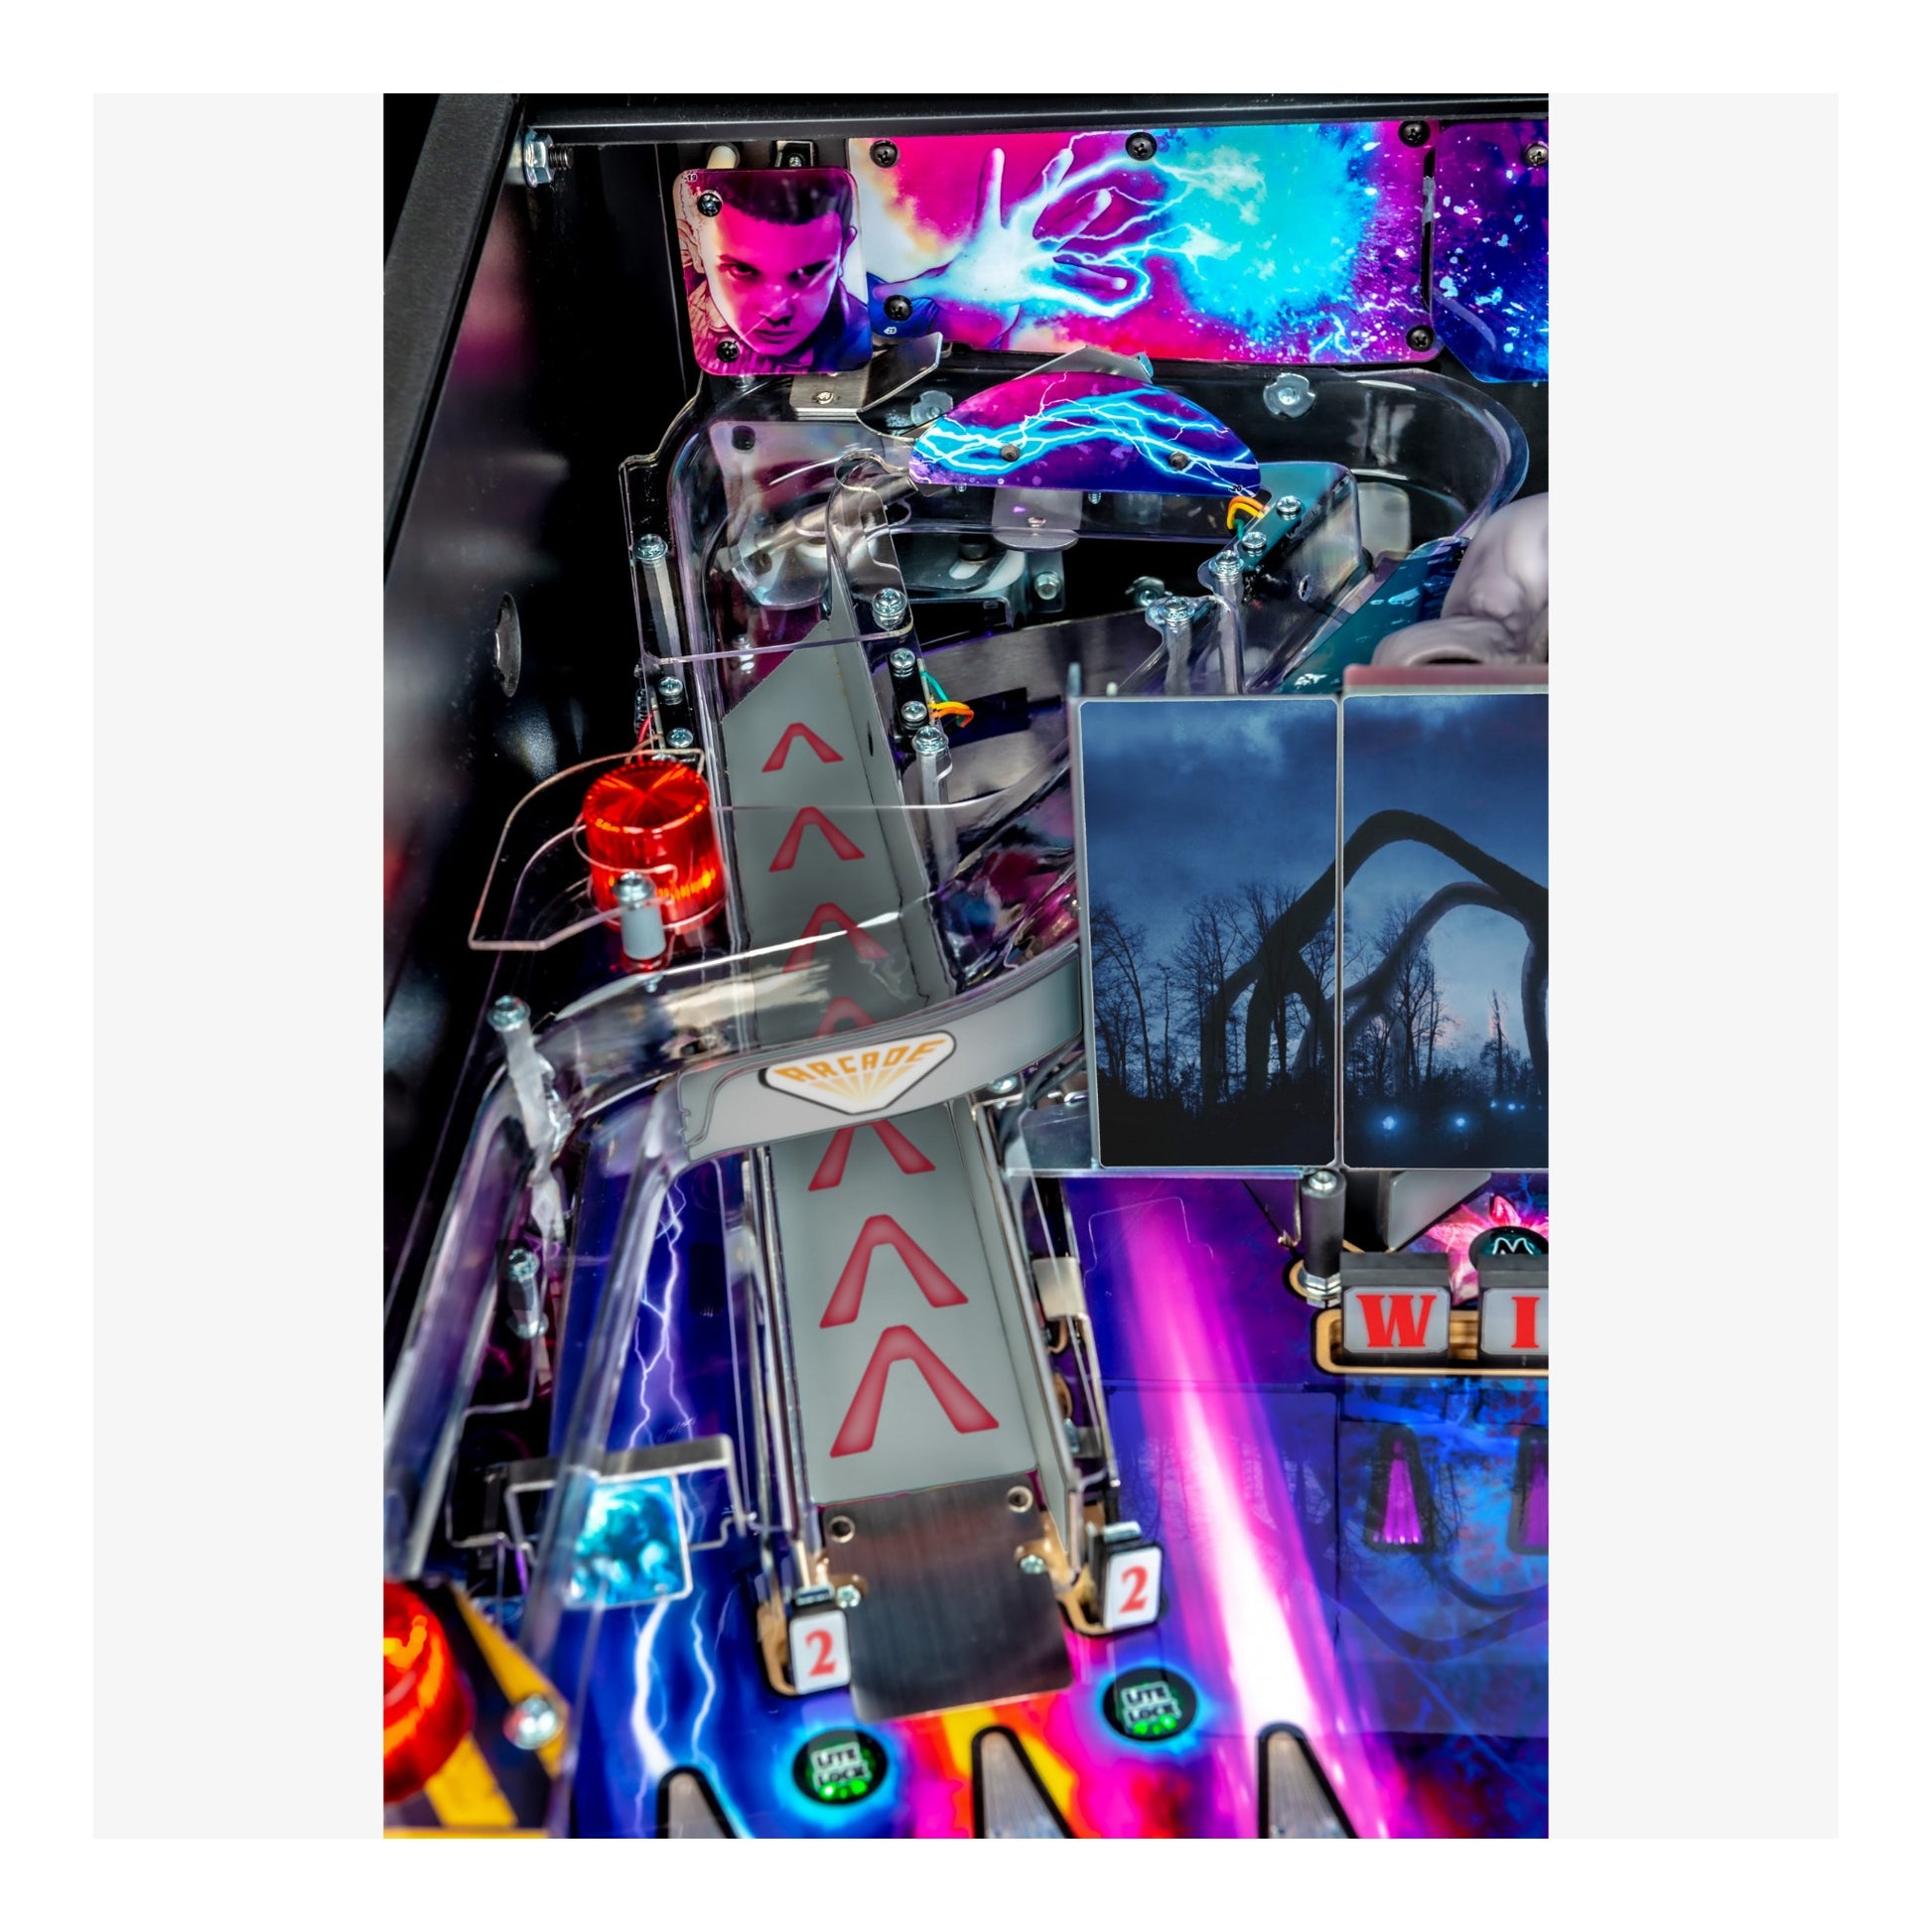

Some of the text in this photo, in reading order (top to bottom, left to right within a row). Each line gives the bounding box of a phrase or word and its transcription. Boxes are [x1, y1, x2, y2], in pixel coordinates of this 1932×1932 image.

[773, 1039, 946, 1082] ARCADE
[1119, 1566, 1148, 1613] 2
[805, 1629, 837, 1676] 2
[1126, 1687, 1166, 1704] LITE
[1128, 1703, 1174, 1723] LOCK
[817, 1748, 856, 1767] LITE
[819, 1766, 865, 1786] LOCK
